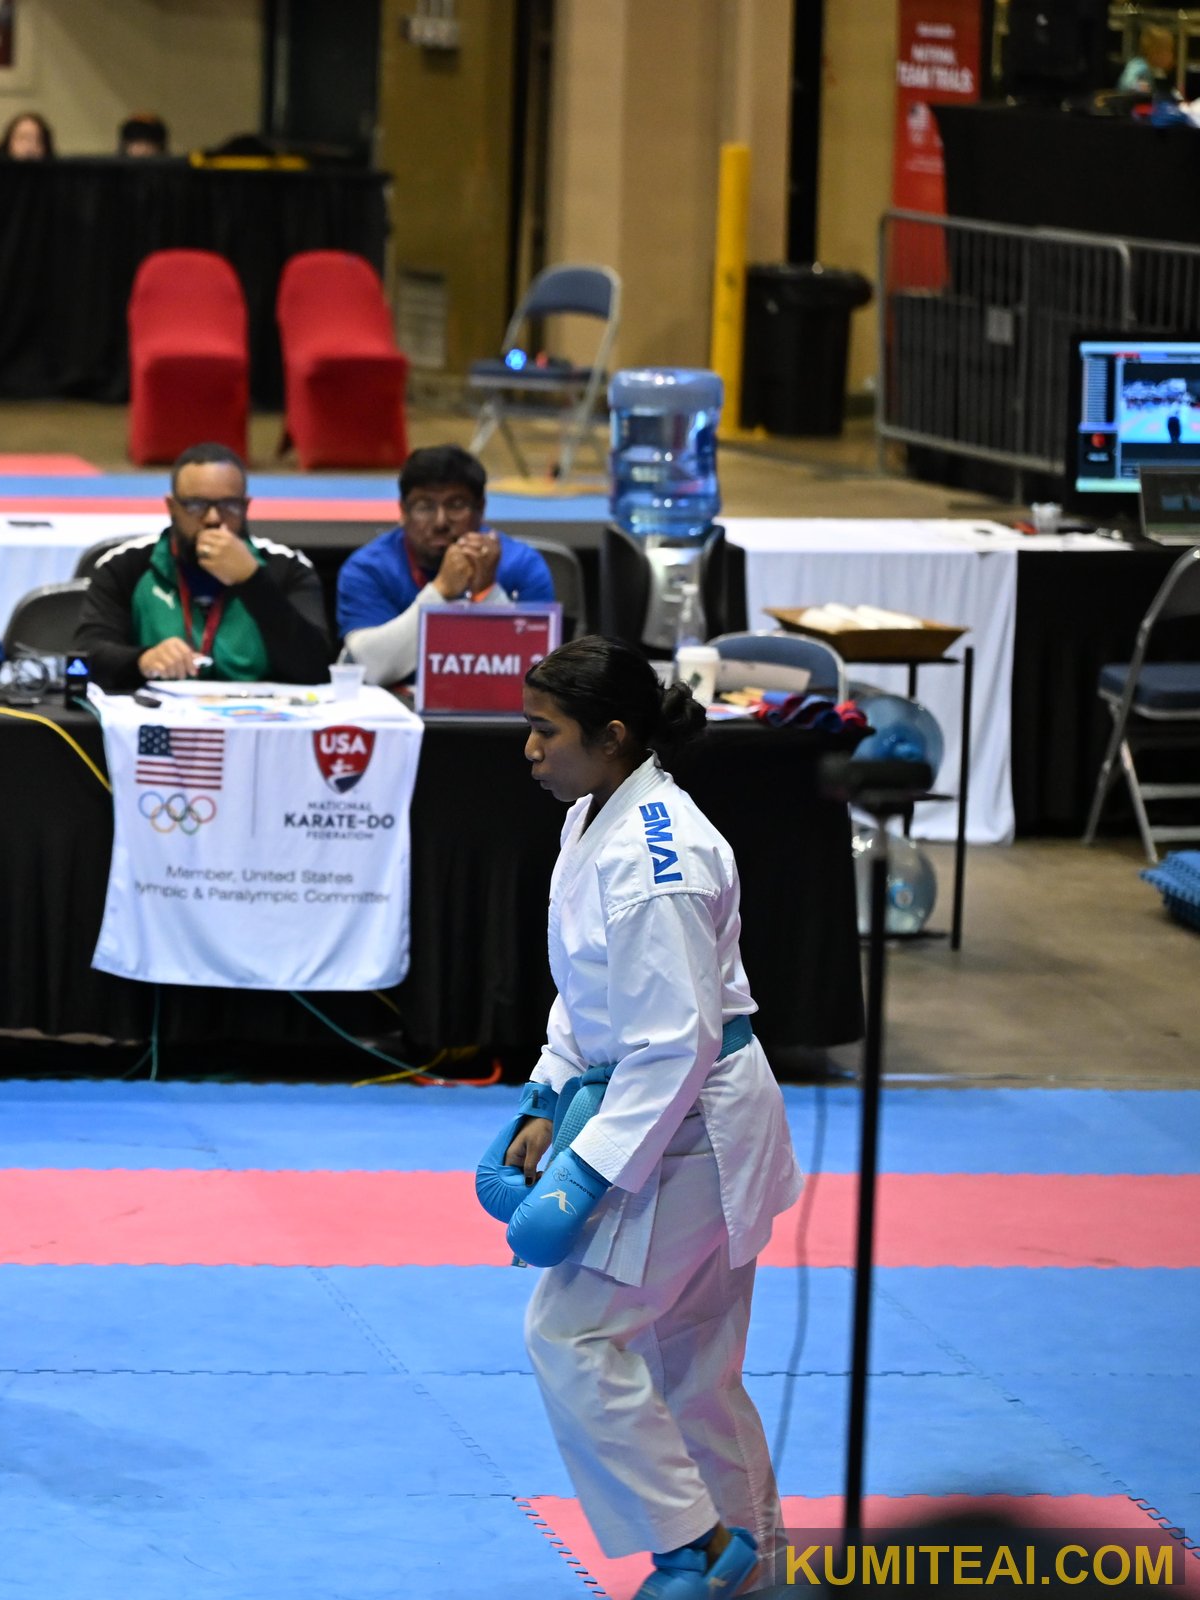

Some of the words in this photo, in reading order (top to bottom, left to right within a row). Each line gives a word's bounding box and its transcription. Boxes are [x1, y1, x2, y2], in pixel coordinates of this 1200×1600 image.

[428, 653, 521, 676] TATAMI
[319, 732, 368, 755] USA
[308, 801, 371, 812] NATIONAL
[284, 813, 396, 830] KARATE-DO
[306, 830, 374, 840] FEDERATION
[639, 801, 683, 885] SMAI
[166, 865, 237, 884] Member,
[241, 867, 297, 884] United
[300, 869, 354, 885] States
[134, 879, 188, 902] lympic
[192, 886, 204, 901] &
[208, 887, 298, 906] Paralympic
